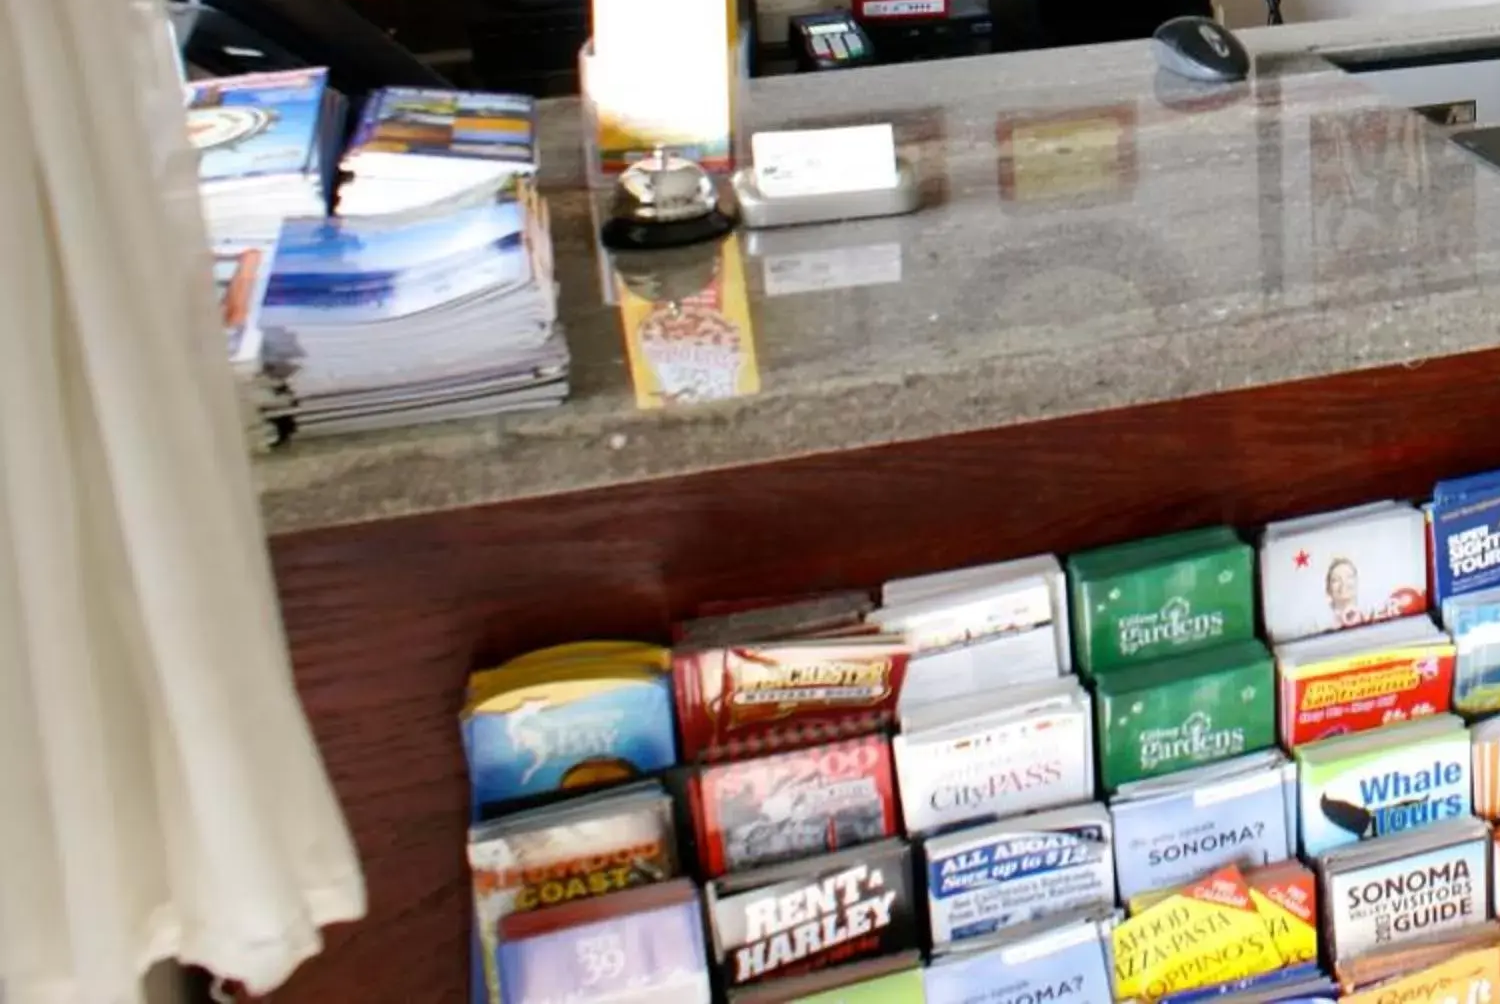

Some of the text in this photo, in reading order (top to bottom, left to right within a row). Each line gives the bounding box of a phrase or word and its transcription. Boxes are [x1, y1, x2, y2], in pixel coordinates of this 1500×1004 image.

[1119, 609, 1225, 655] gardens
[1139, 725, 1244, 770] gardens
[929, 760, 1063, 812] CityPASS
[1360, 760, 1463, 807] Whale
[941, 827, 1100, 876] ALL ABOARD
[991, 861, 1017, 880] up
[1021, 854, 1042, 871] to
[1148, 821, 1266, 868] SONOMA?
[513, 866, 632, 911] COAST
[746, 863, 884, 945] RENT A
[1347, 857, 1472, 910] SONOMA
[1391, 880, 1474, 917] VISITORS
[735, 889, 895, 982] HARLEY
[1392, 896, 1474, 934] GUIDE
[581, 949, 626, 987] 39
